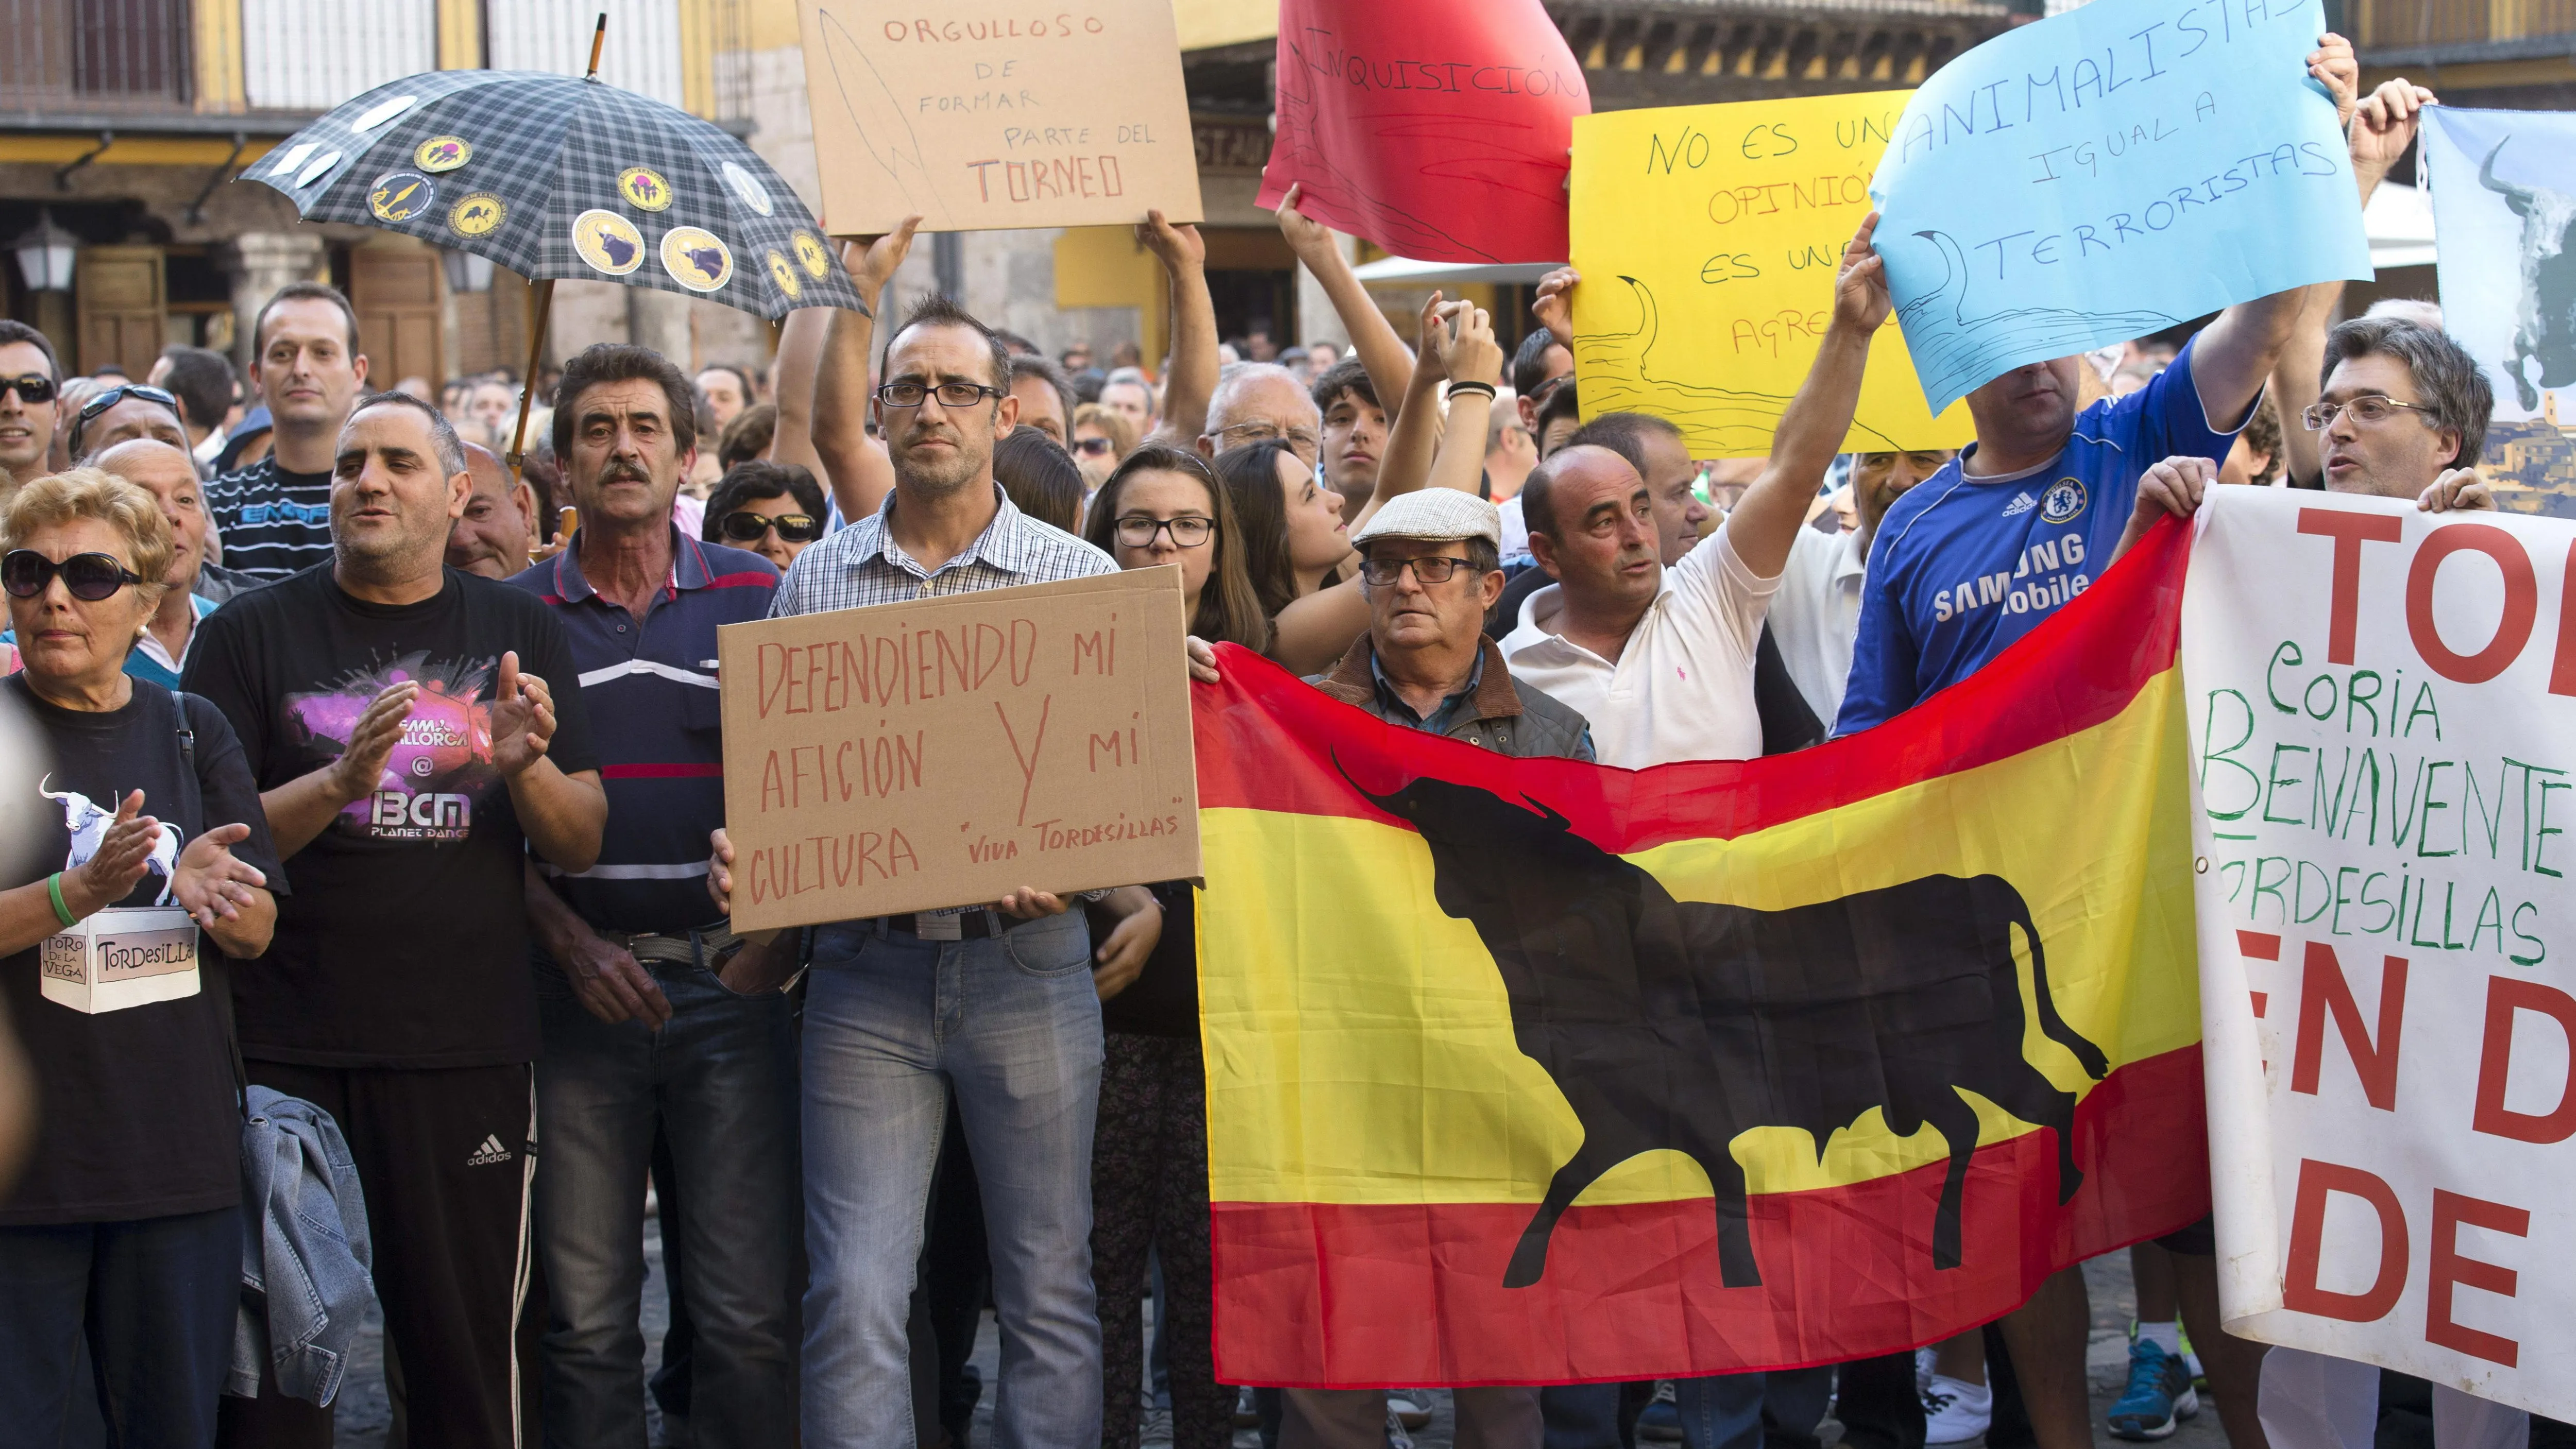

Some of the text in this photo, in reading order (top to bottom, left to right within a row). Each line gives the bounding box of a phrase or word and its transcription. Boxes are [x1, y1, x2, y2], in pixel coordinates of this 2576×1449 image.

[884, 14, 1105, 43] ORGULLOSO
[975, 59, 1018, 80] DE
[1306, 27, 1581, 97] INQUISICIÓN
[920, 90, 1040, 113] FORMAR
[1004, 124, 1157, 149] PARTE DEL
[1648, 110, 1905, 175] NO ES UN
[2028, 92, 2216, 183] IGUAL A
[967, 155, 1123, 203] TORNEO
[1974, 141, 2336, 280] TERRORISTAS
[1701, 253, 1760, 284] ES
[2002, 499, 2038, 517] adidas
[2297, 507, 2576, 697] TO
[757, 612, 1117, 720] DEFENDIENDO MI
[761, 694, 1139, 826] AFICIÓN Y MI
[2201, 689, 2572, 878] BENAVENTE
[371, 827, 470, 838] PLANET DANCE
[750, 827, 919, 905] CULTURA
[43, 960, 83, 978] VEGA
[467, 1150, 512, 1166] adidas
[2283, 1157, 2530, 1369] DE
